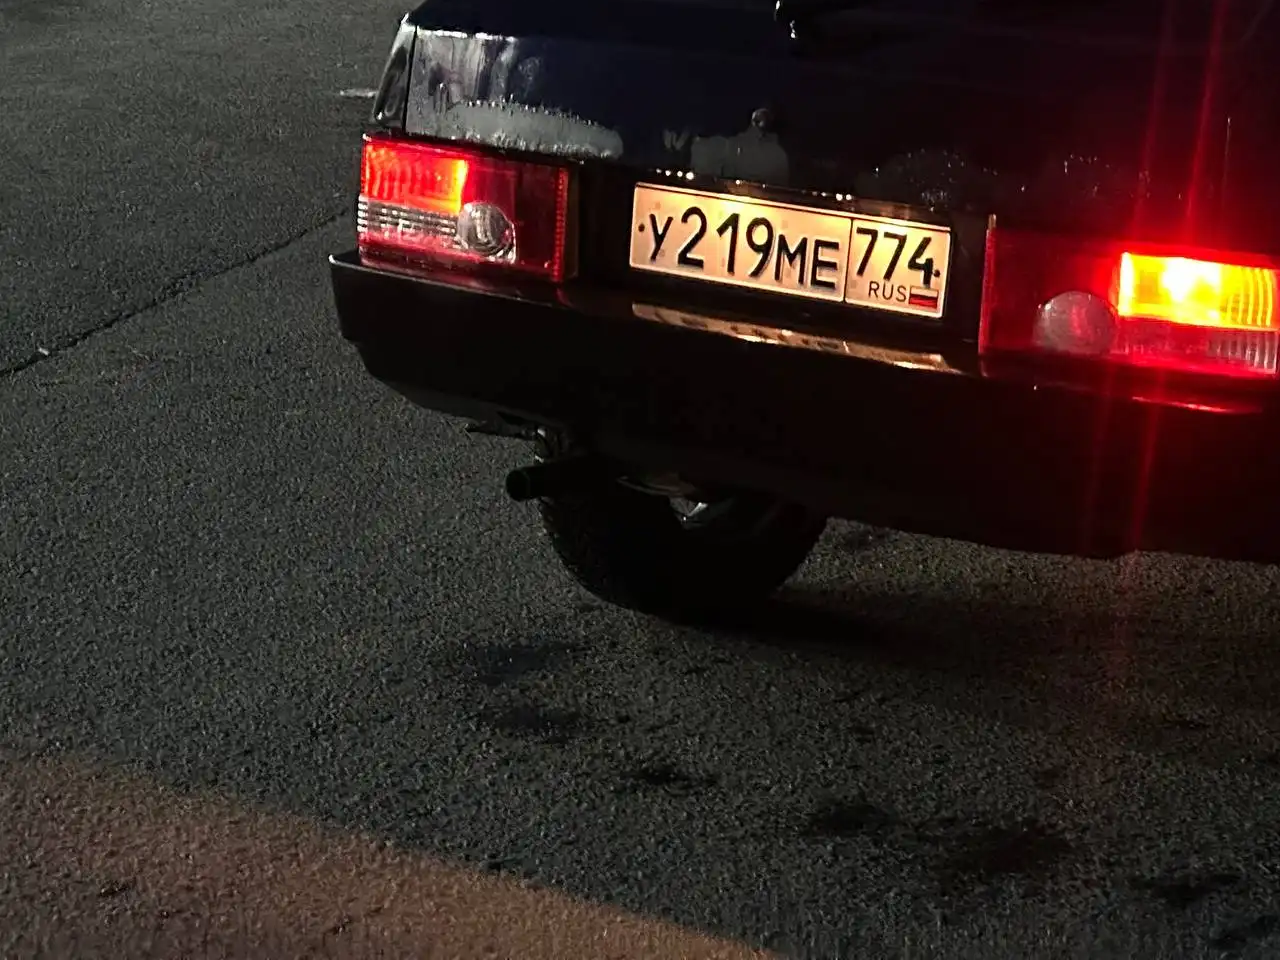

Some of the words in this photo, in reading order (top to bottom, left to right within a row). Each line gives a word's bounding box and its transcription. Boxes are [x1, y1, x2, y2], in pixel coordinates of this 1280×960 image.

[649, 205, 840, 289] У219МЕ
[855, 227, 934, 288] 774
[868, 280, 907, 302] RUS
